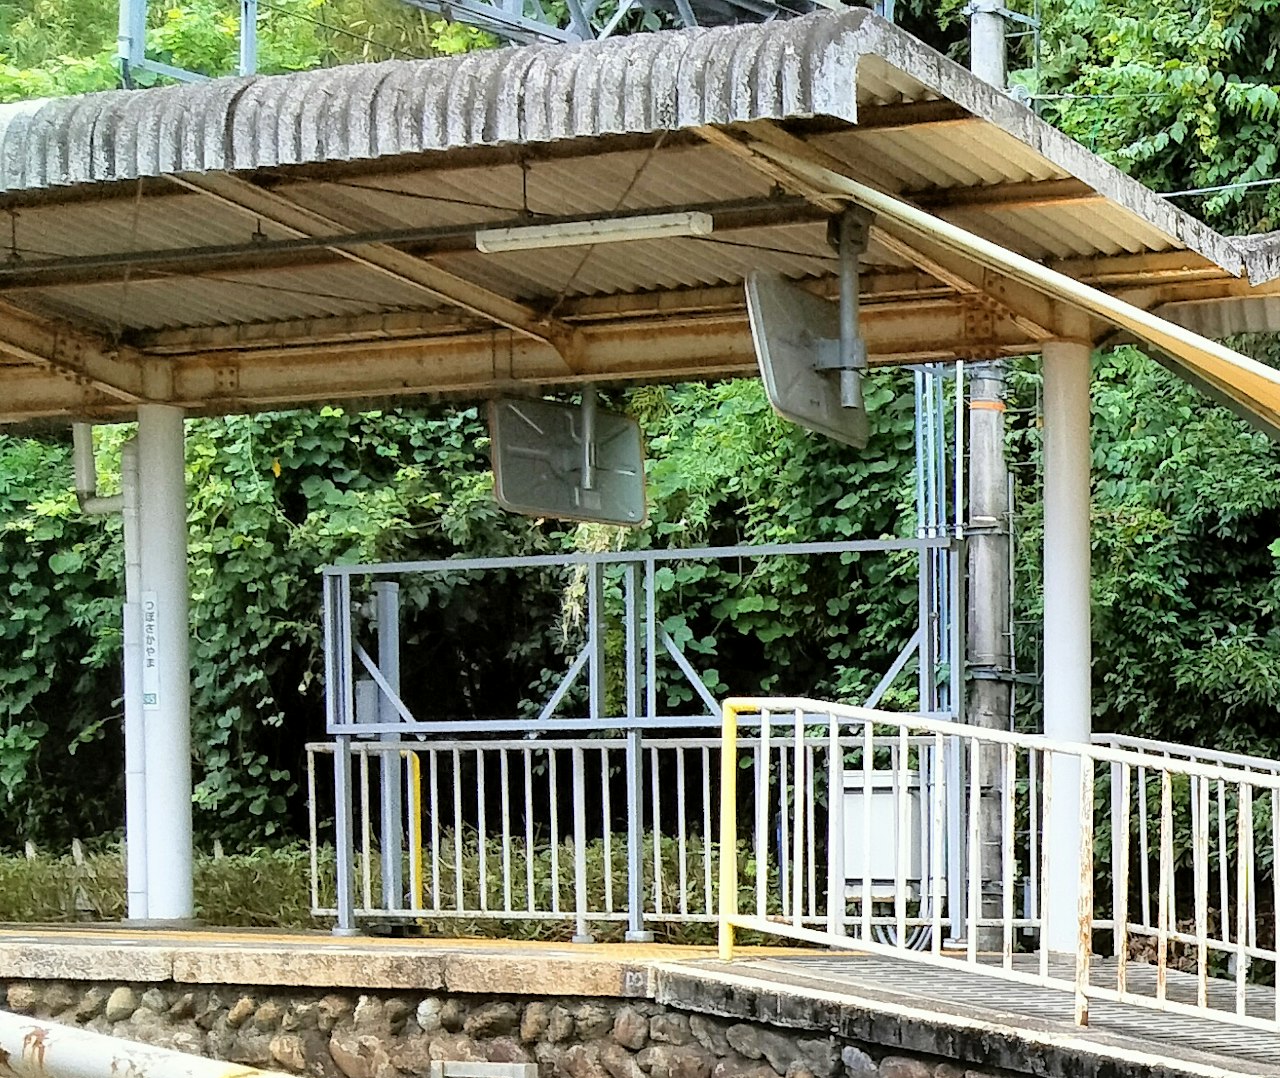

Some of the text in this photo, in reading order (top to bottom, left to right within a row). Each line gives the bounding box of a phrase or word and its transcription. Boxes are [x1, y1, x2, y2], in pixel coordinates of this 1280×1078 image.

[145, 601, 156, 668] つぼさかやま
